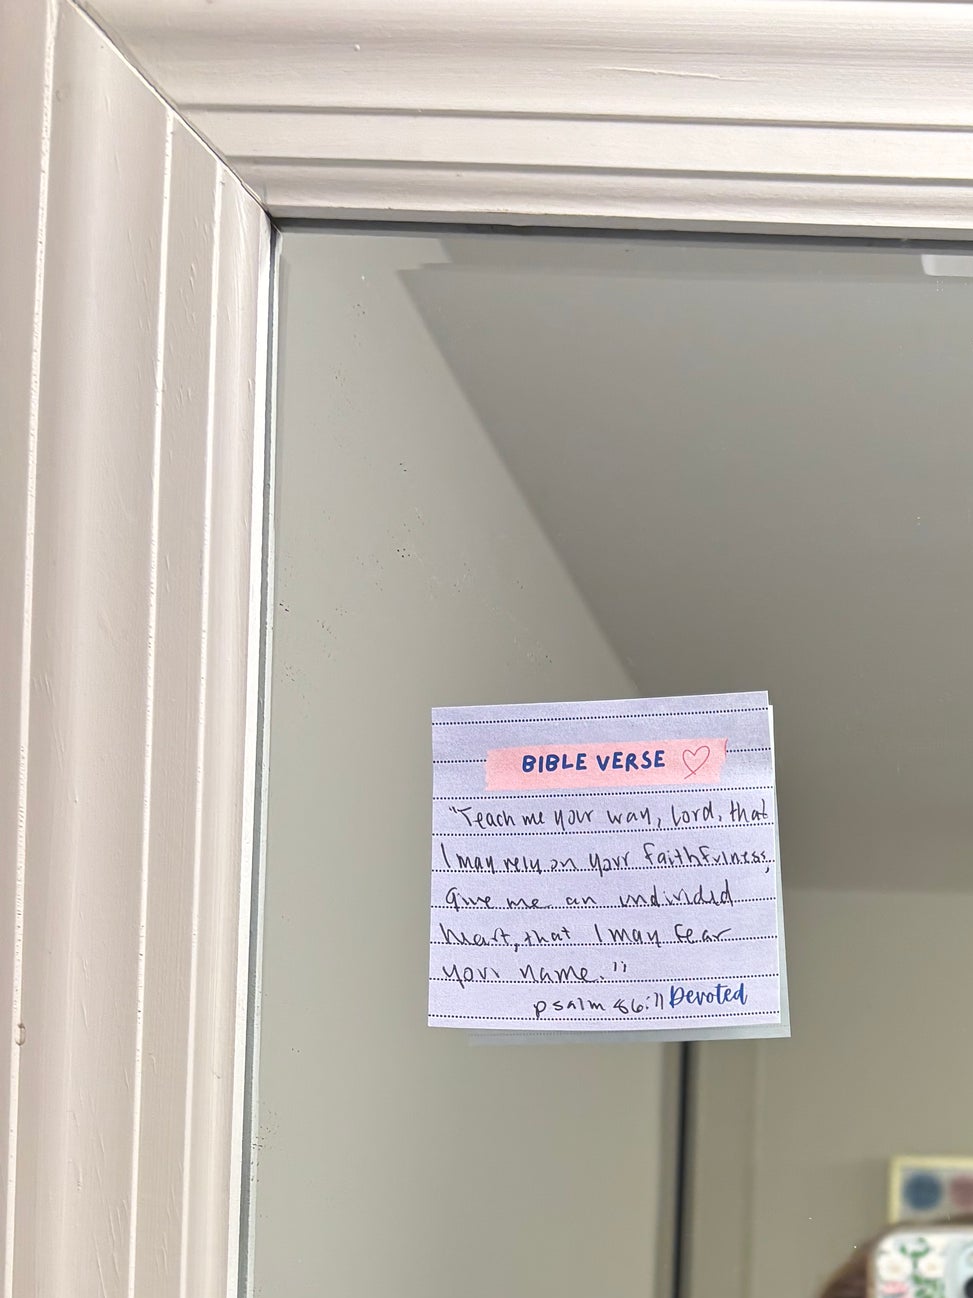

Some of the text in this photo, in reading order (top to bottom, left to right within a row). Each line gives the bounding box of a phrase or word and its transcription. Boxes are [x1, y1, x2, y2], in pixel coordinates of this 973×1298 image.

[521, 750, 666, 773] BIBLE VERSE
[448, 806, 516, 830] "Teach
[522, 810, 546, 826] me
[554, 809, 594, 832] your
[606, 807, 662, 829] way,
[729, 798, 769, 823] that
[440, 842, 451, 869] I
[455, 853, 496, 875] may
[502, 855, 543, 875] rely
[549, 857, 578, 871] on
[588, 851, 630, 878] your
[506, 897, 552, 910] me
[565, 896, 597, 906] an
[523, 926, 571, 946] that
[593, 923, 603, 943] I
[607, 927, 662, 948] may
[668, 982, 748, 1009] Devoted
